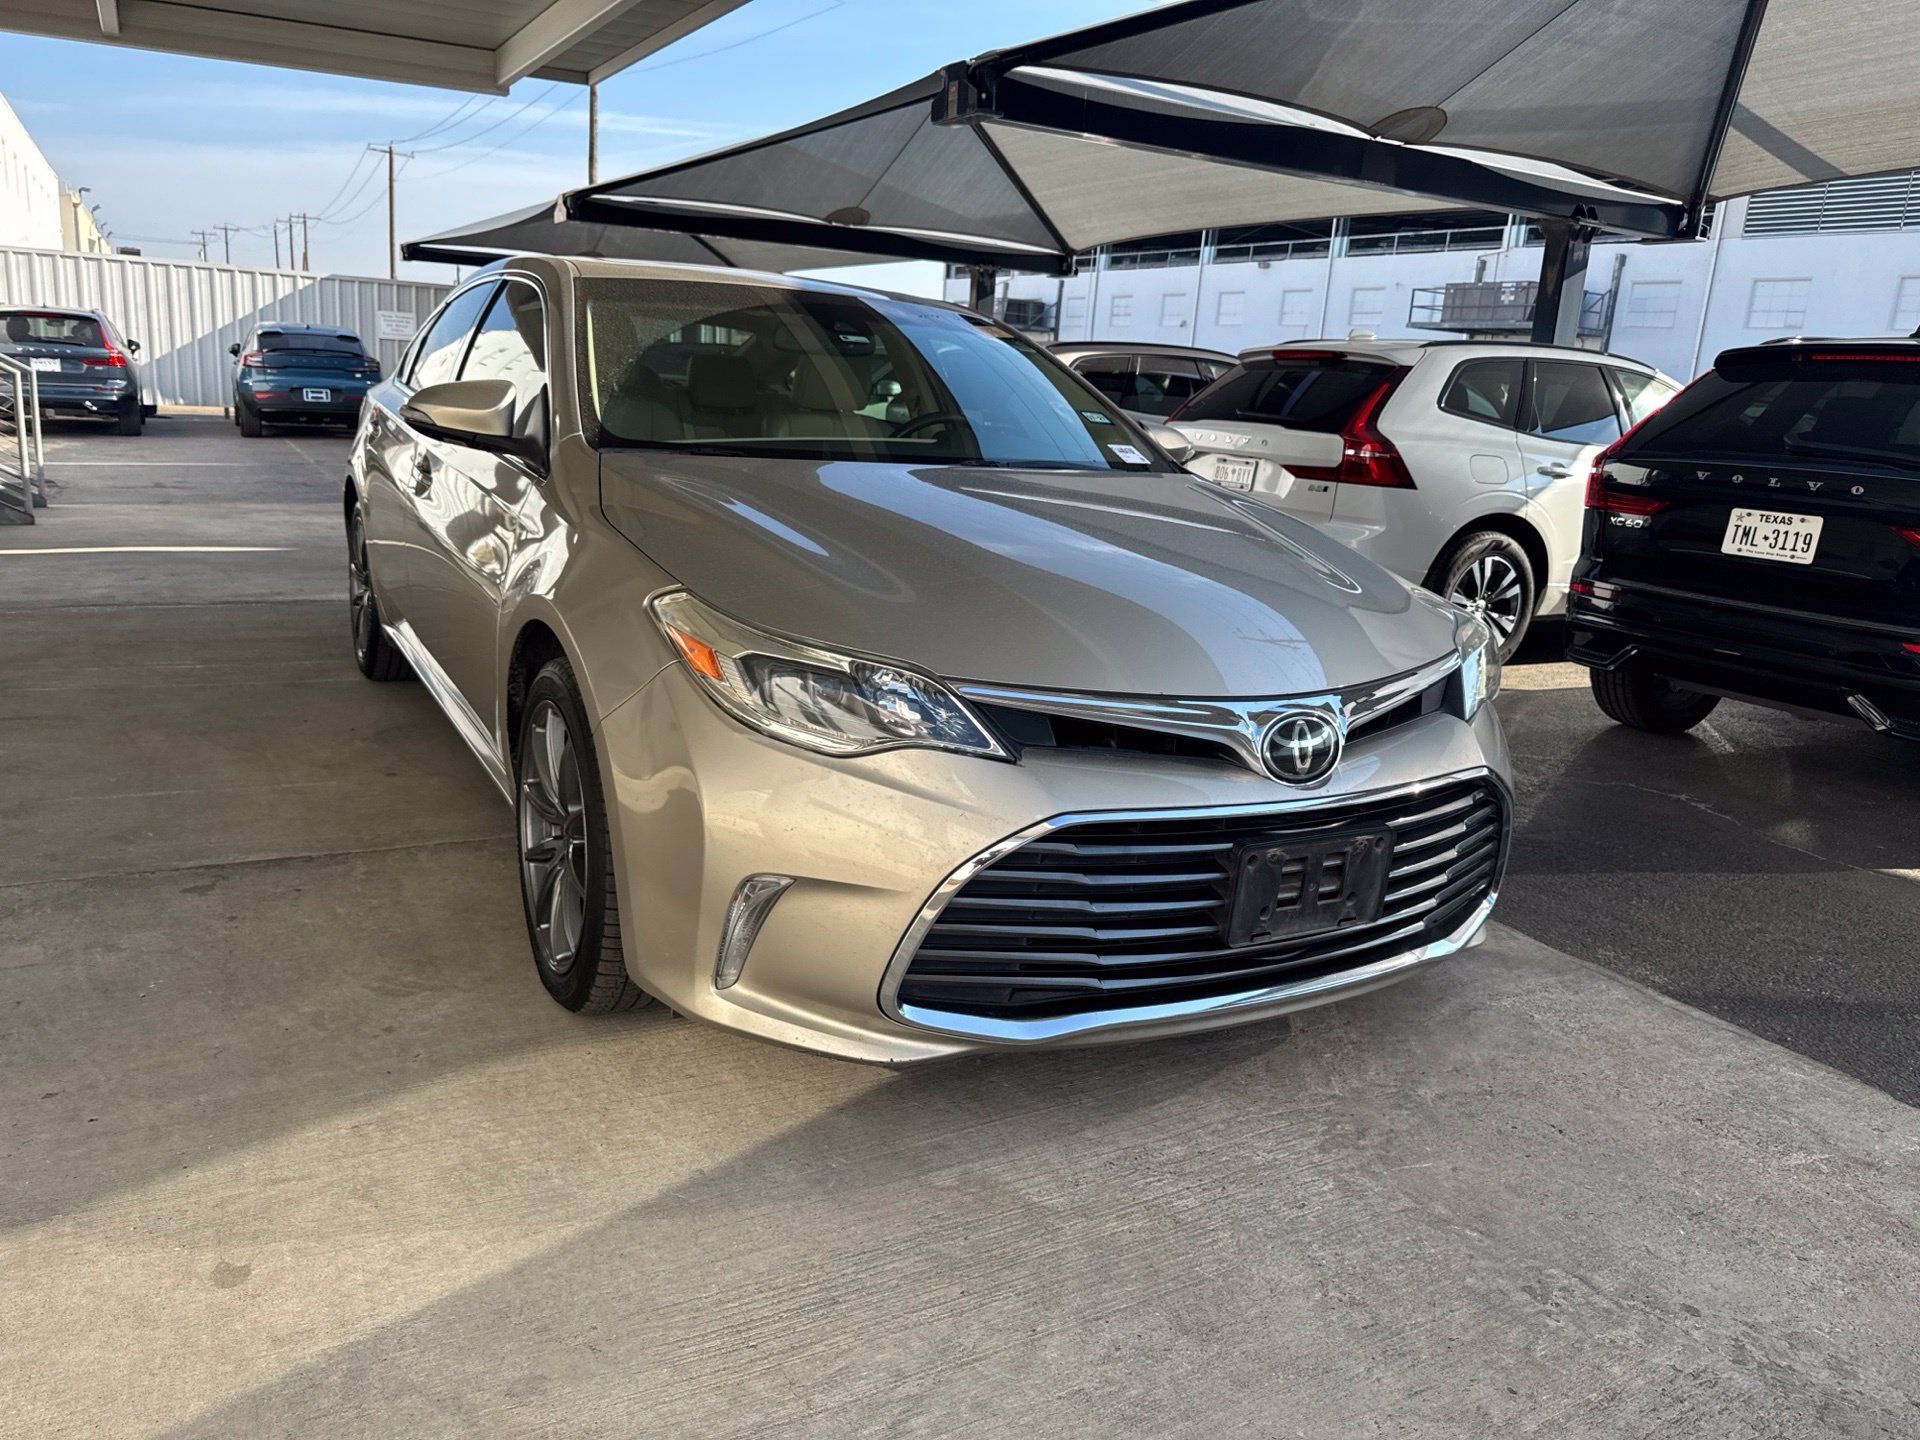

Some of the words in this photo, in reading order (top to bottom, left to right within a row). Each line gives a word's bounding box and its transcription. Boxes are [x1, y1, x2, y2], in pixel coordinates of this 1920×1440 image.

[1195, 432, 1268, 447] VOLVO
[1696, 471, 1865, 495] VOLVO
[1610, 516, 1643, 529] XC60
[1759, 514, 1794, 526] TEXAS
[1731, 524, 1758, 547] TML
[1769, 529, 1813, 553] 3119
